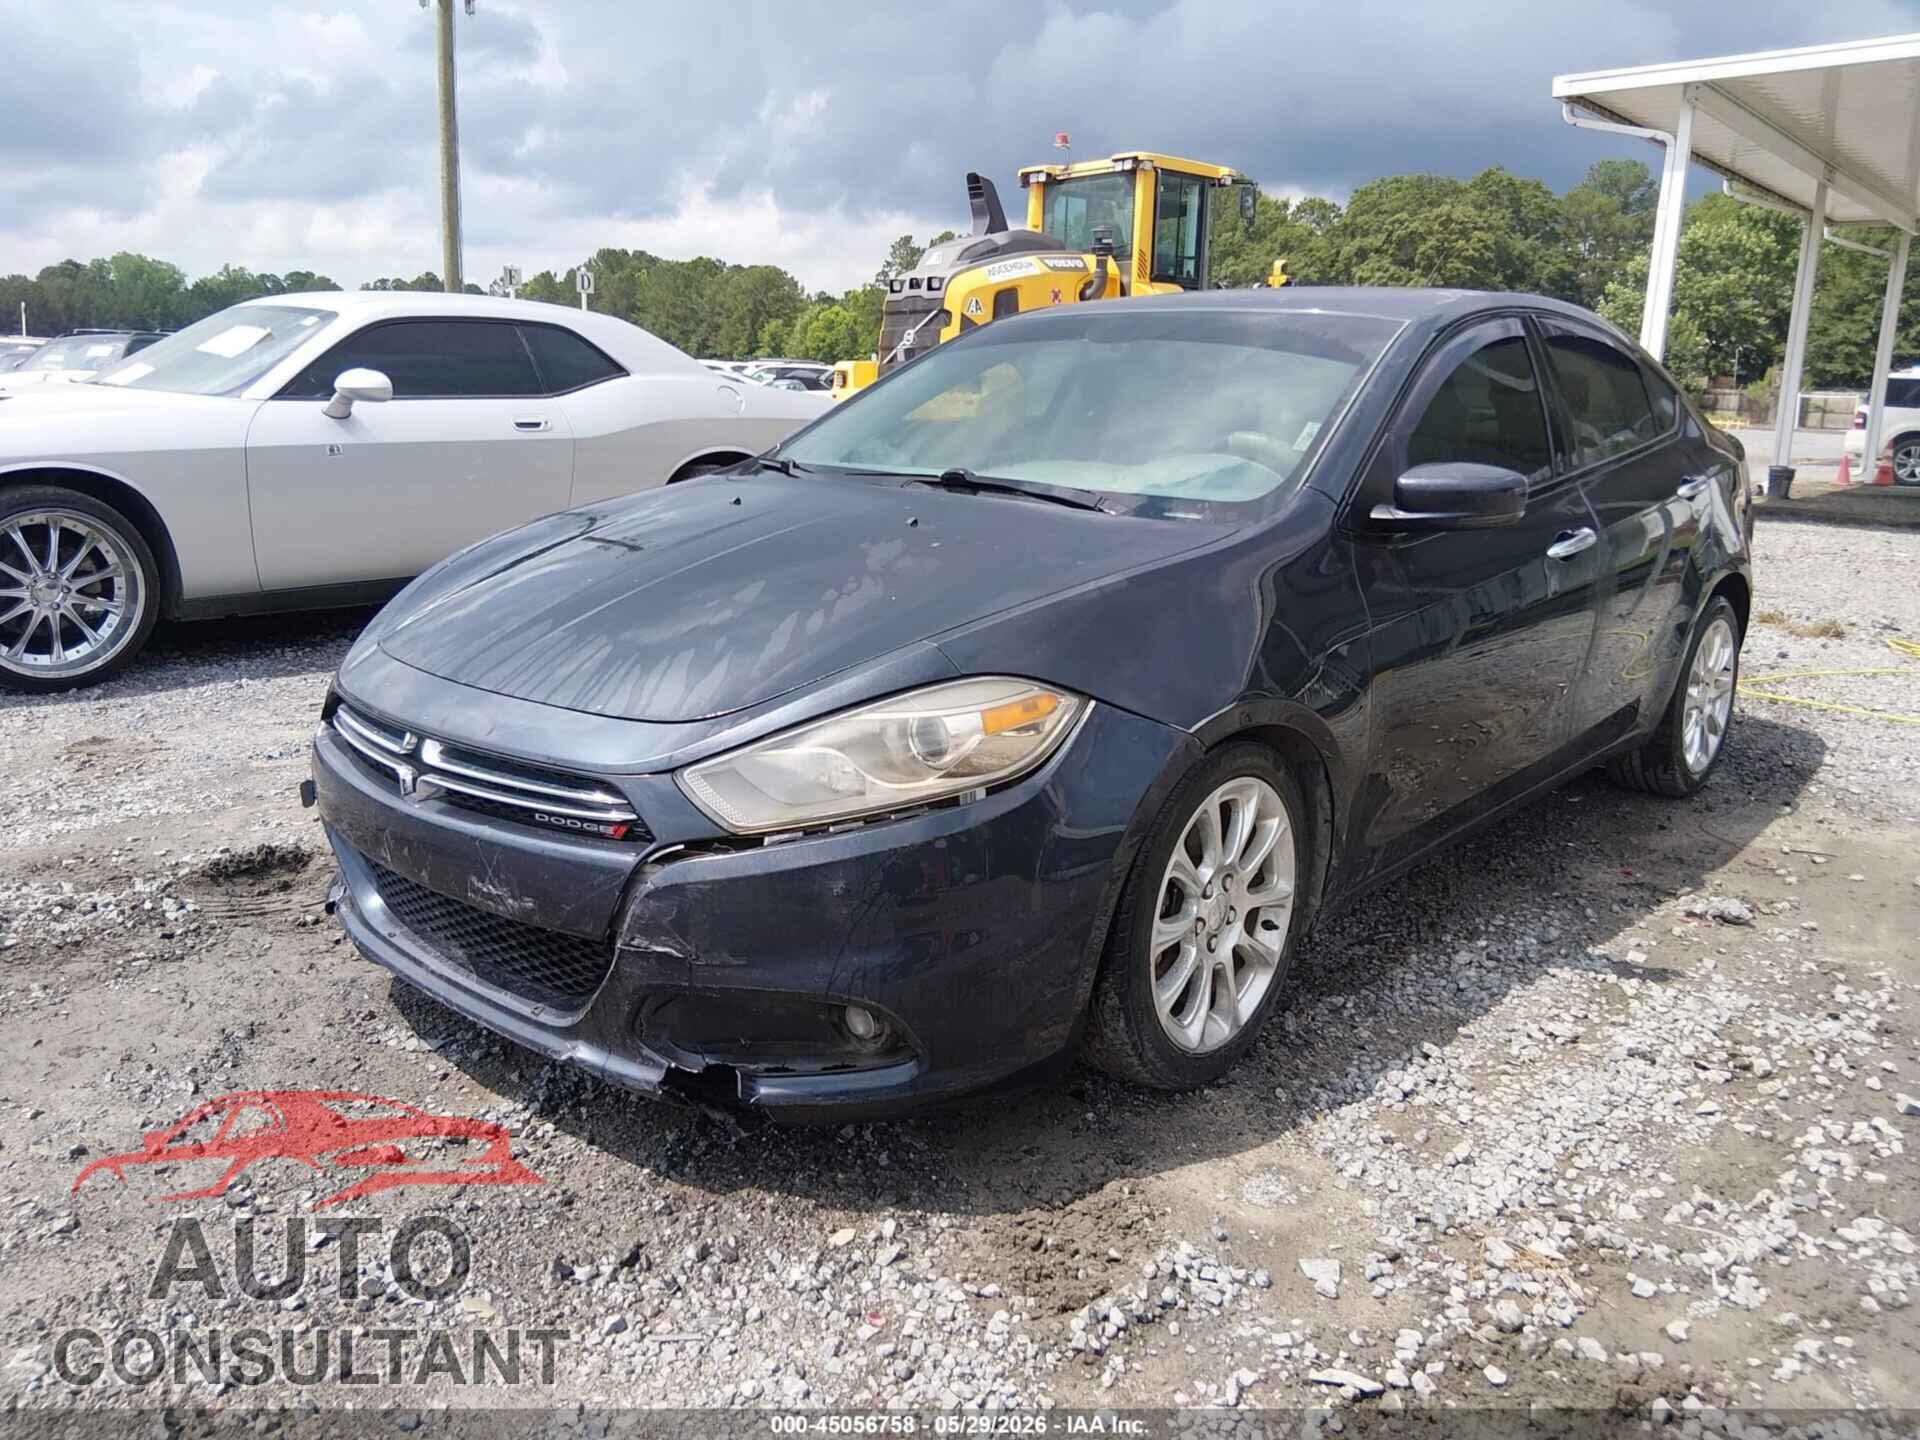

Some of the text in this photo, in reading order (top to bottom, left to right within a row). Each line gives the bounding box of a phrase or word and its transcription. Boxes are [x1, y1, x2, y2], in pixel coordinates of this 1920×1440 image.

[1044, 258, 1085, 268] VOLVO
[580, 273, 591, 290] D
[534, 812, 614, 834] DODGE
